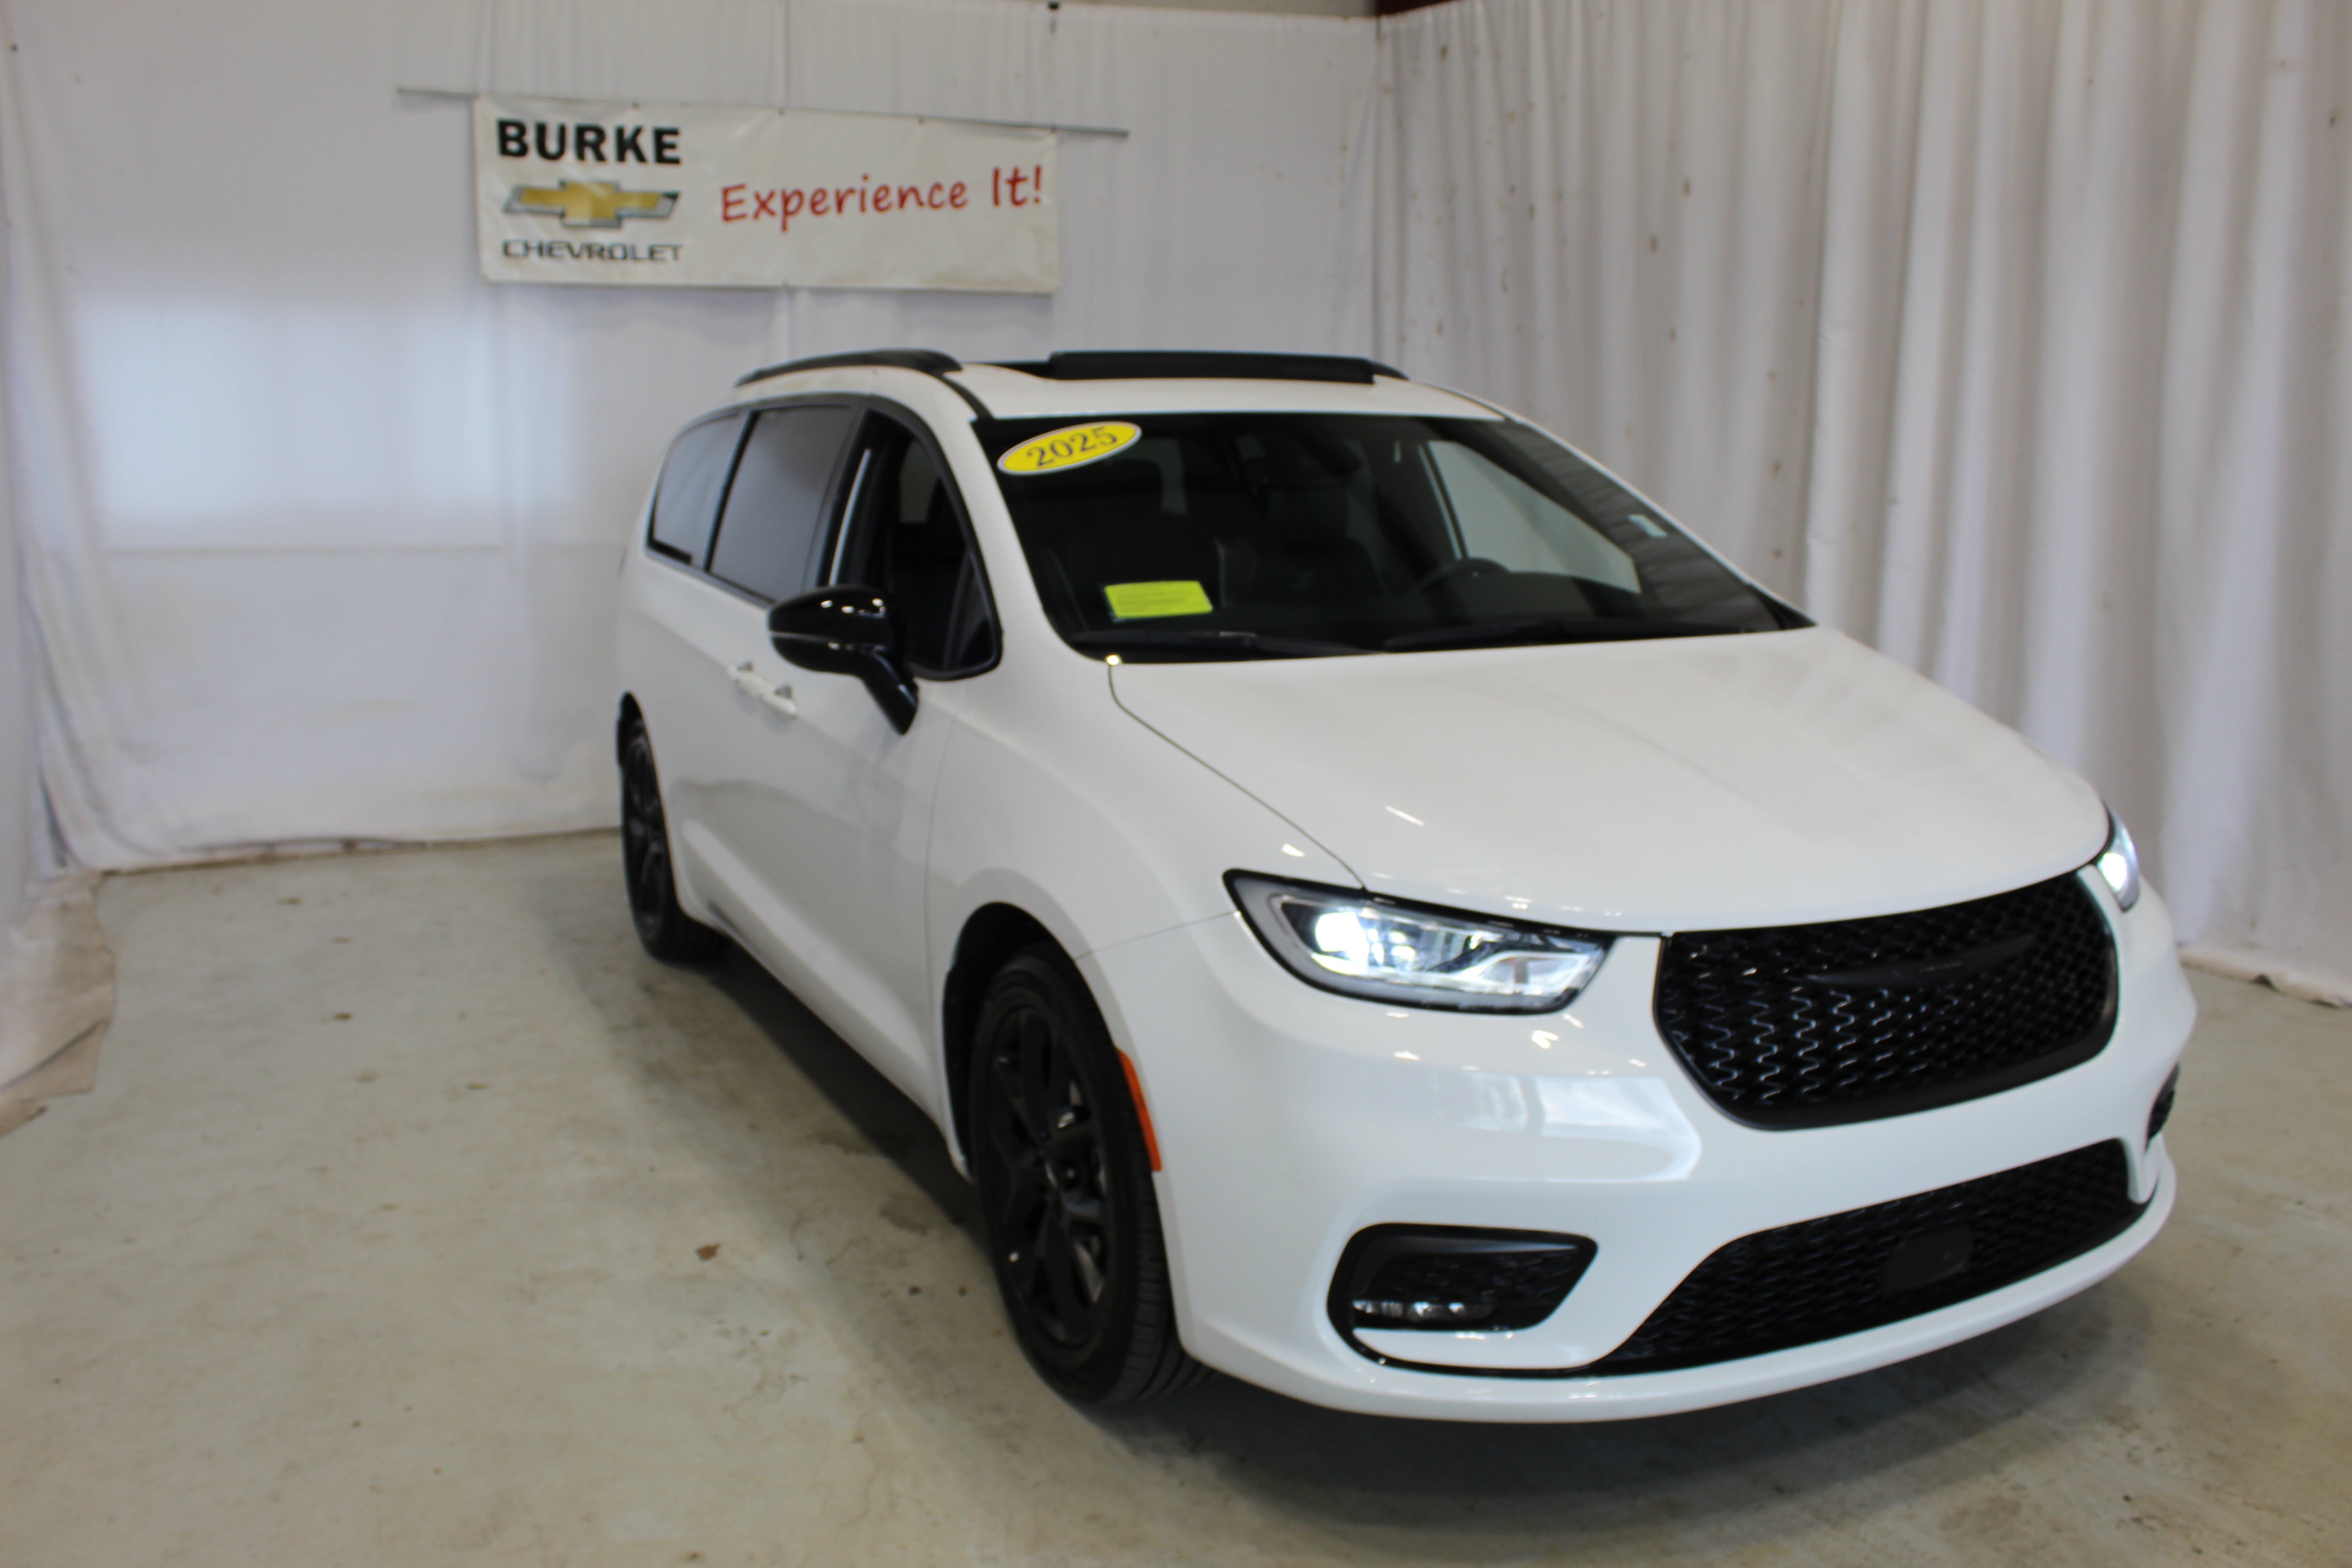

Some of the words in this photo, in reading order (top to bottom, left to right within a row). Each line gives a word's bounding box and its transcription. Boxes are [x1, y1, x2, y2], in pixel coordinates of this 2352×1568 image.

[497, 118, 682, 165] BURKE
[721, 173, 968, 233] Experience
[992, 164, 1042, 207] It!
[502, 240, 684, 261] CHEVROLET
[1026, 426, 1118, 467] 2025
